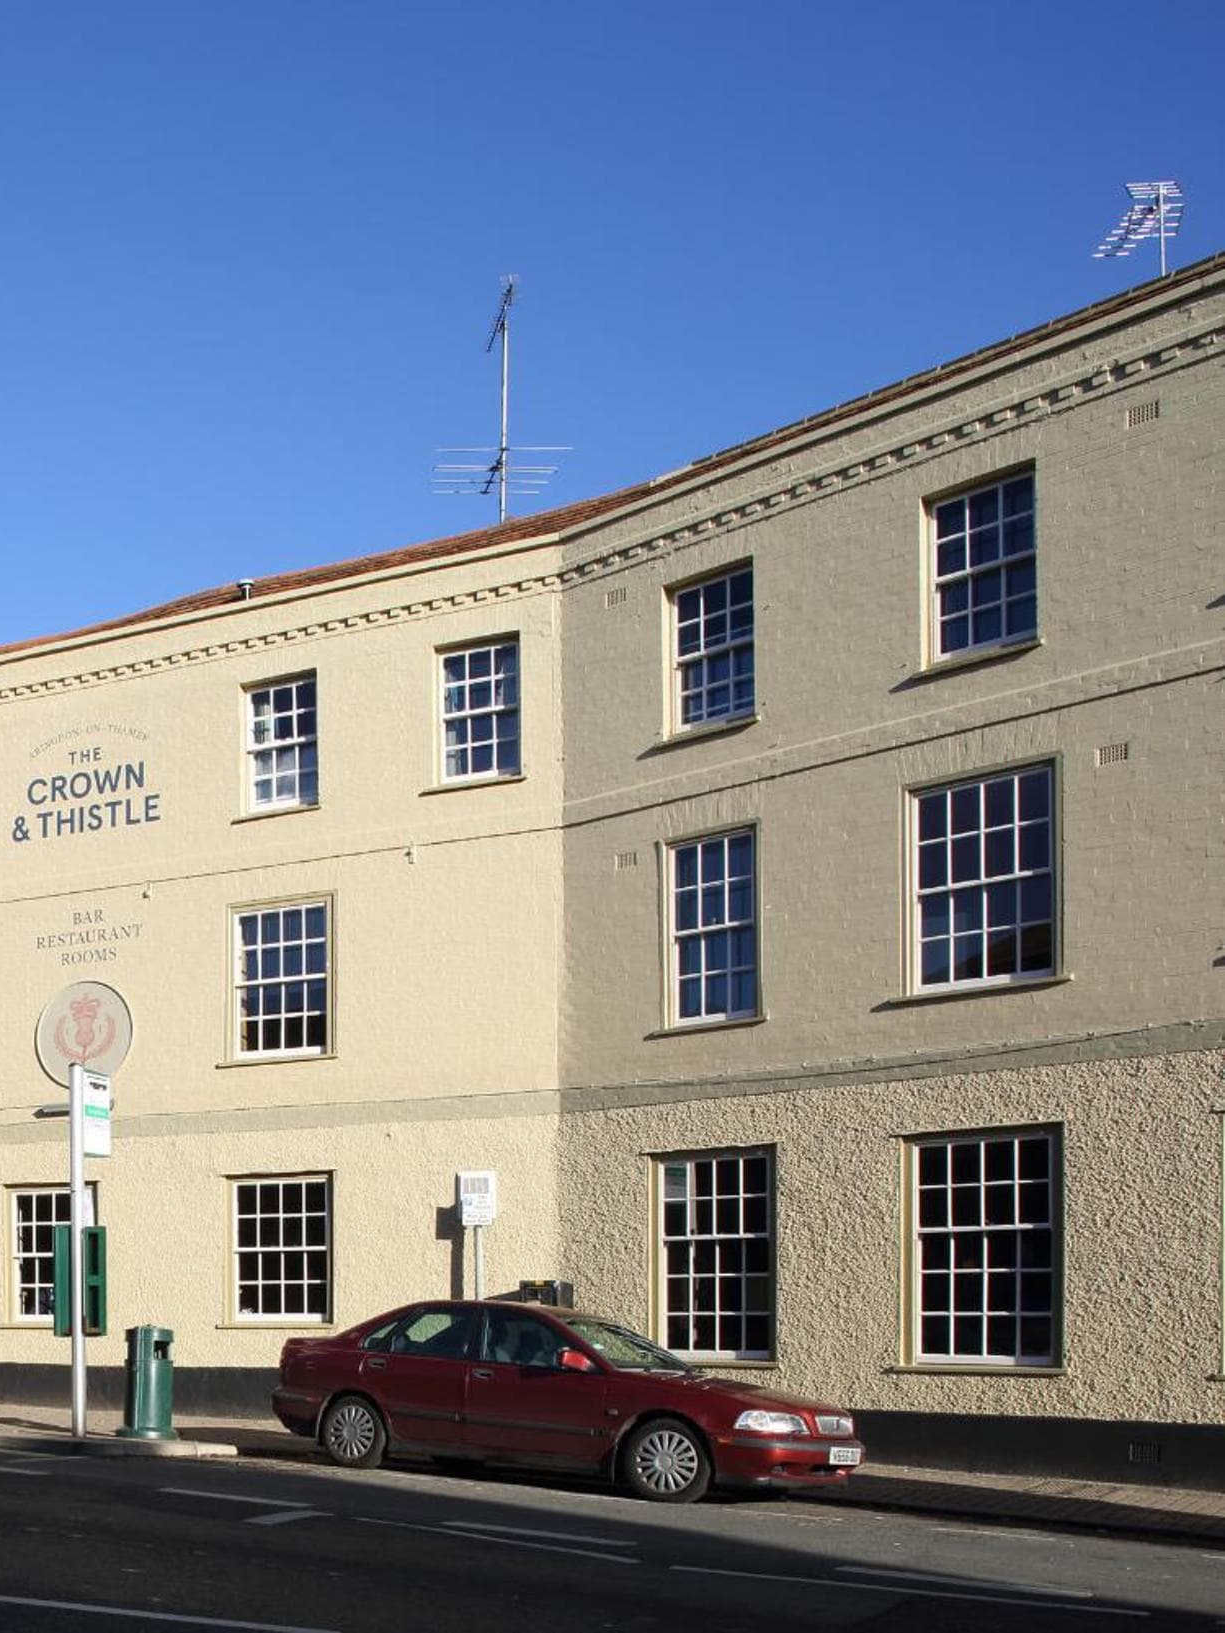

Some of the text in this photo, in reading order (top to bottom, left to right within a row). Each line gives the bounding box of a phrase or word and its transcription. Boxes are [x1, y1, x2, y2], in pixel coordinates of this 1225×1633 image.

[68, 747, 103, 765] THE
[27, 762, 145, 805] CROWN
[12, 794, 161, 842] & THISTLE
[72, 909, 104, 925] BAR
[36, 924, 143, 949] RESTAURANT
[61, 947, 117, 966] ROOMS
